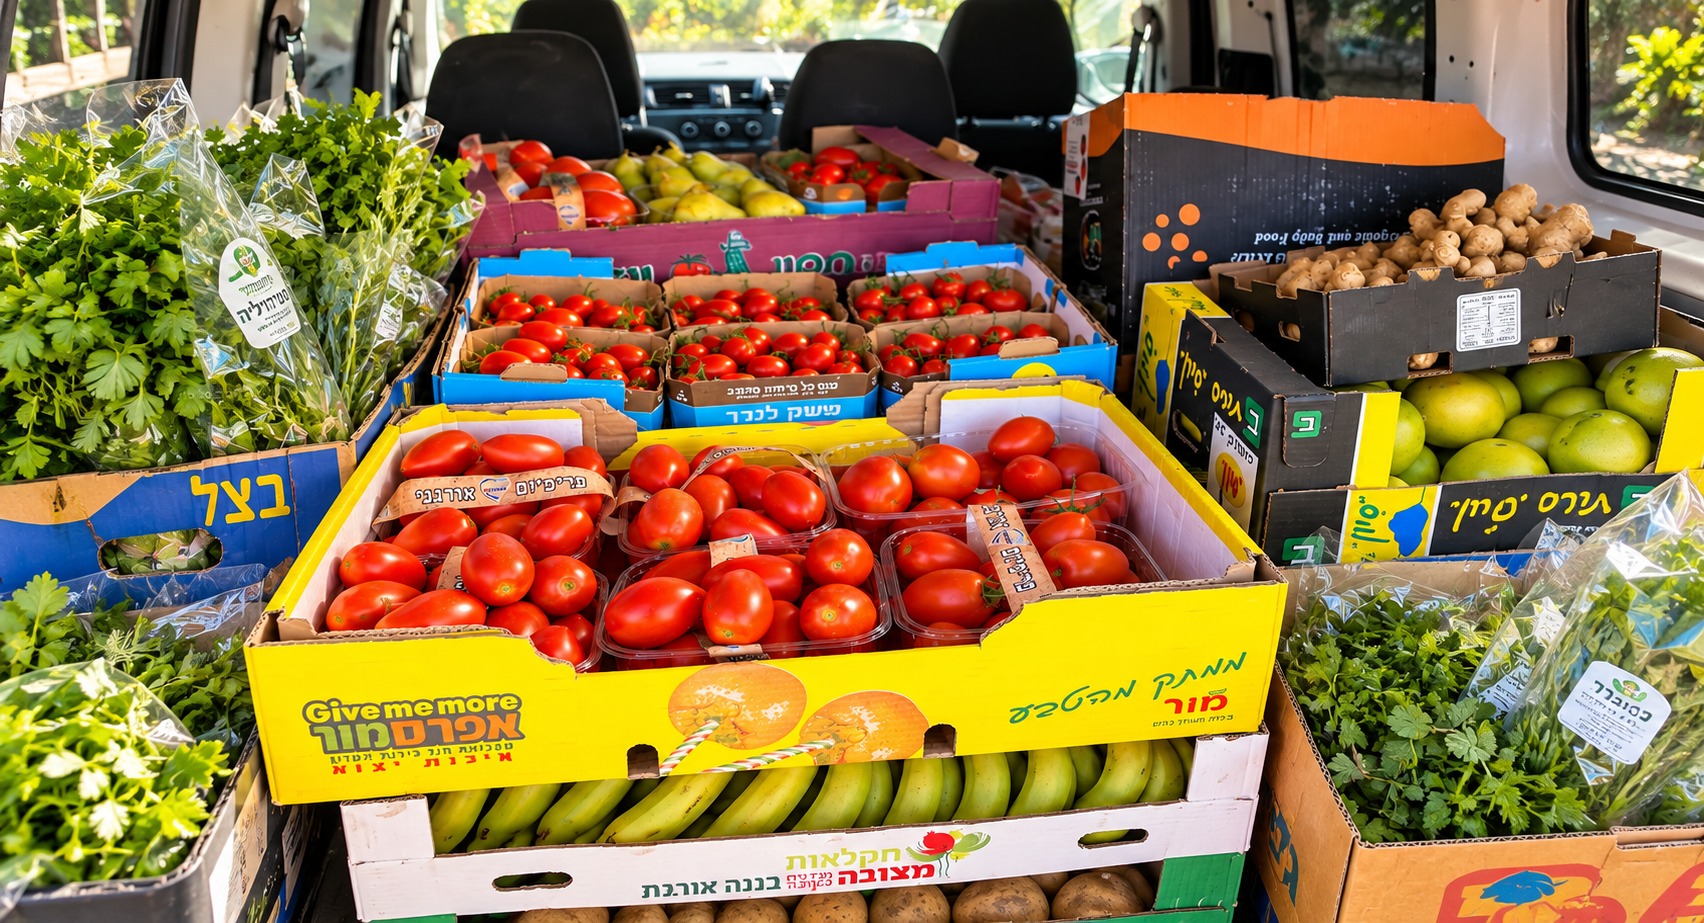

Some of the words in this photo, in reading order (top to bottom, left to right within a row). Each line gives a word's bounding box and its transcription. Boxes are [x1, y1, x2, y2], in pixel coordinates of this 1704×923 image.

[190, 473, 291, 527] בצל
[303, 698, 381, 724] Give
[437, 694, 520, 716] more
[1163, 694, 1229, 715] מור
[786, 847, 901, 870] חקלאות
[724, 875, 781, 894] בננה
[837, 864, 935, 886] מצובה
